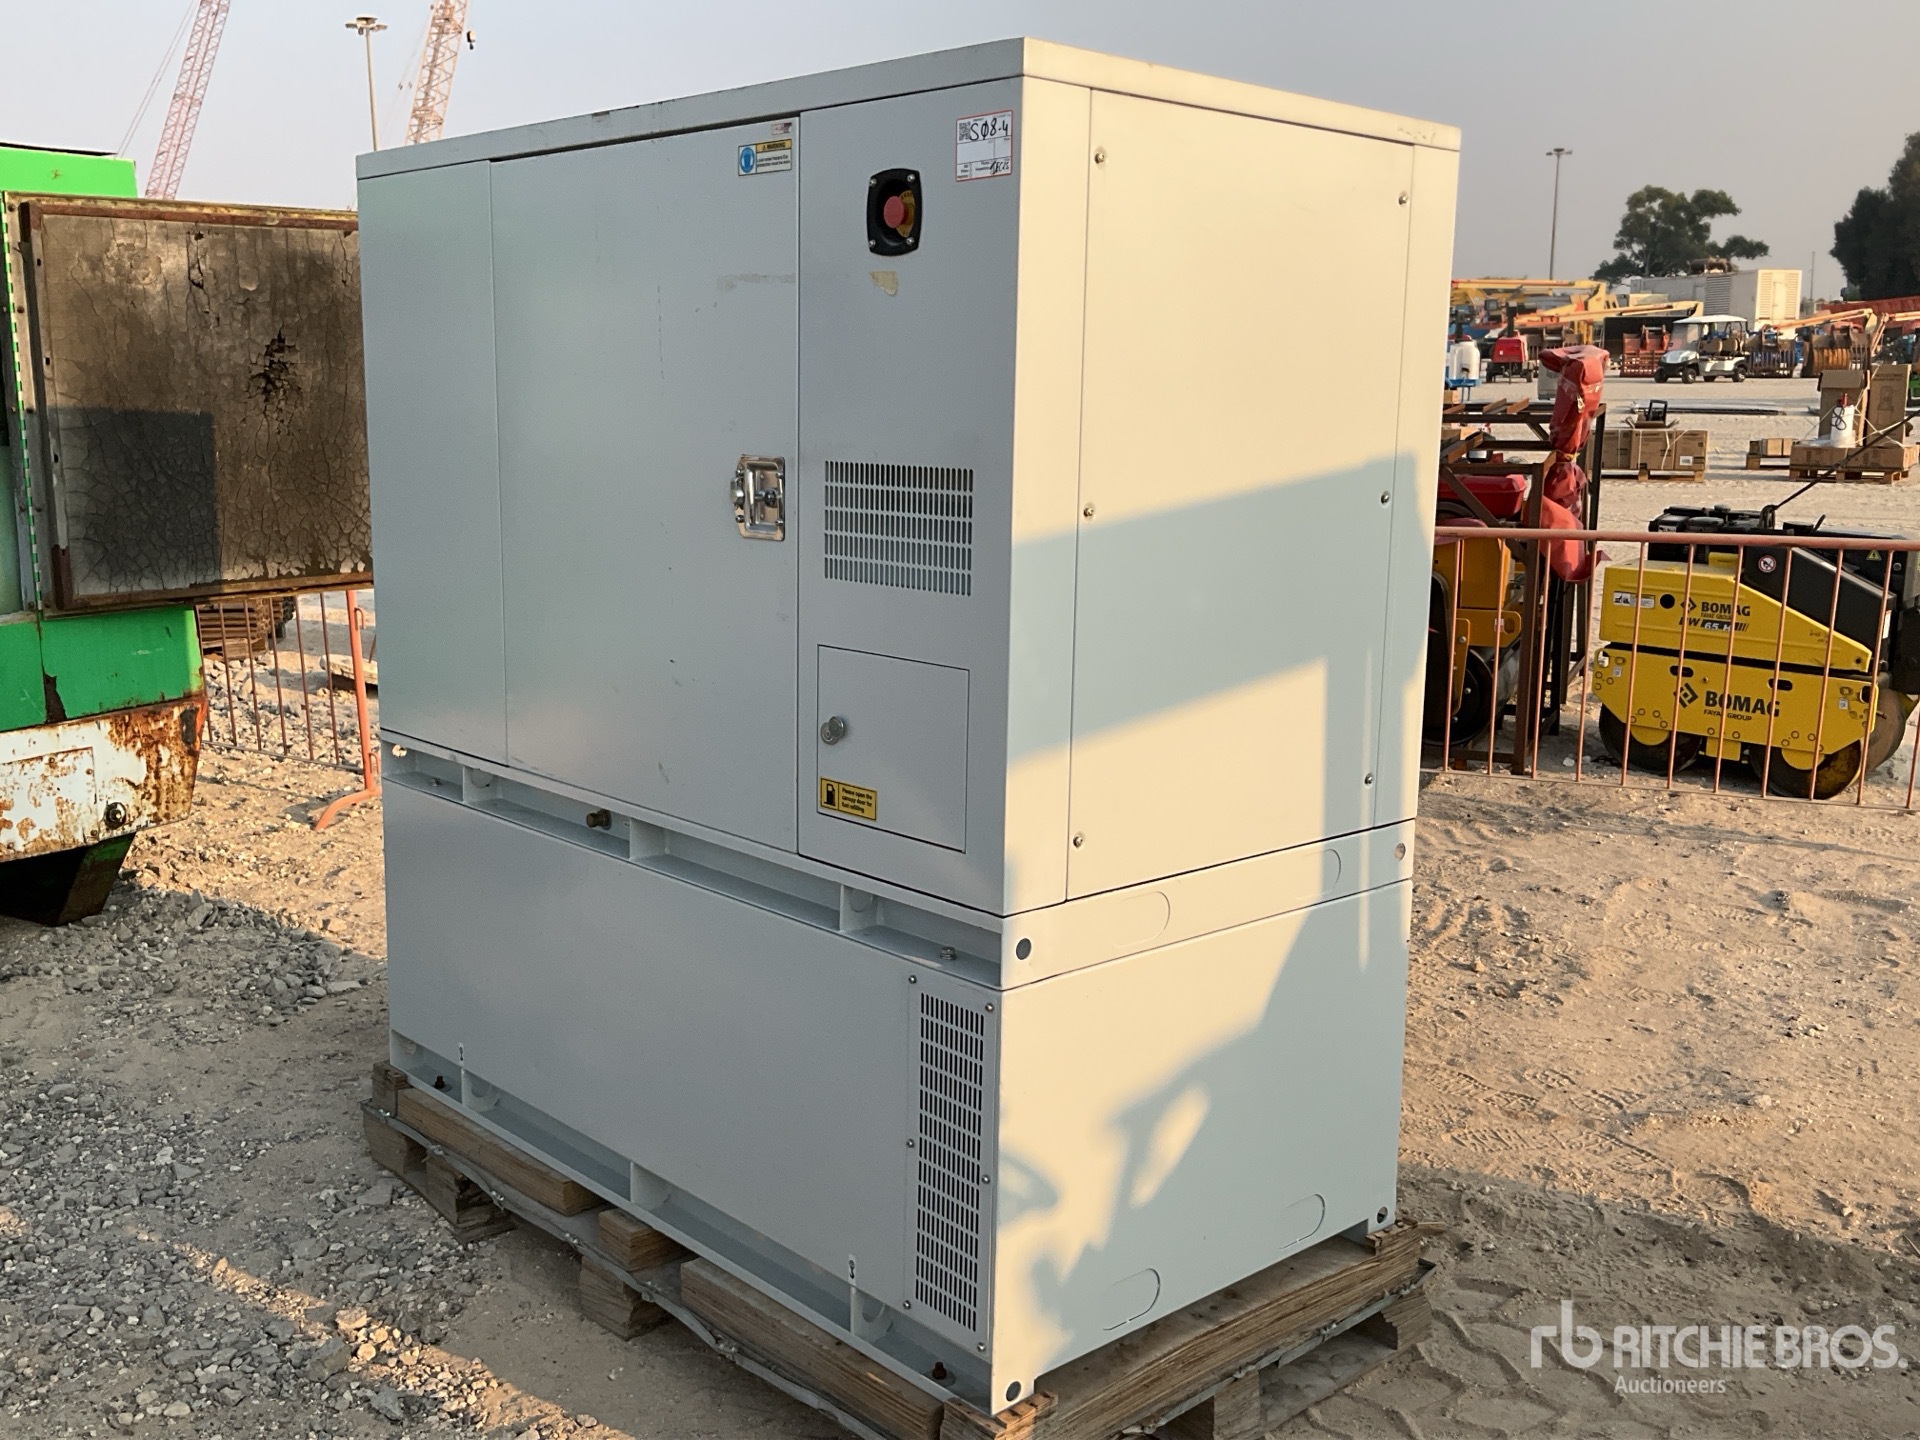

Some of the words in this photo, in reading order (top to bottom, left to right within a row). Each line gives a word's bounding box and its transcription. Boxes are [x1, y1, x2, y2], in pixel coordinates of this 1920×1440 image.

[1701, 601, 1751, 616] BOMAG
[1704, 622, 1719, 631] 65
[1704, 690, 1780, 717] BOMAG
